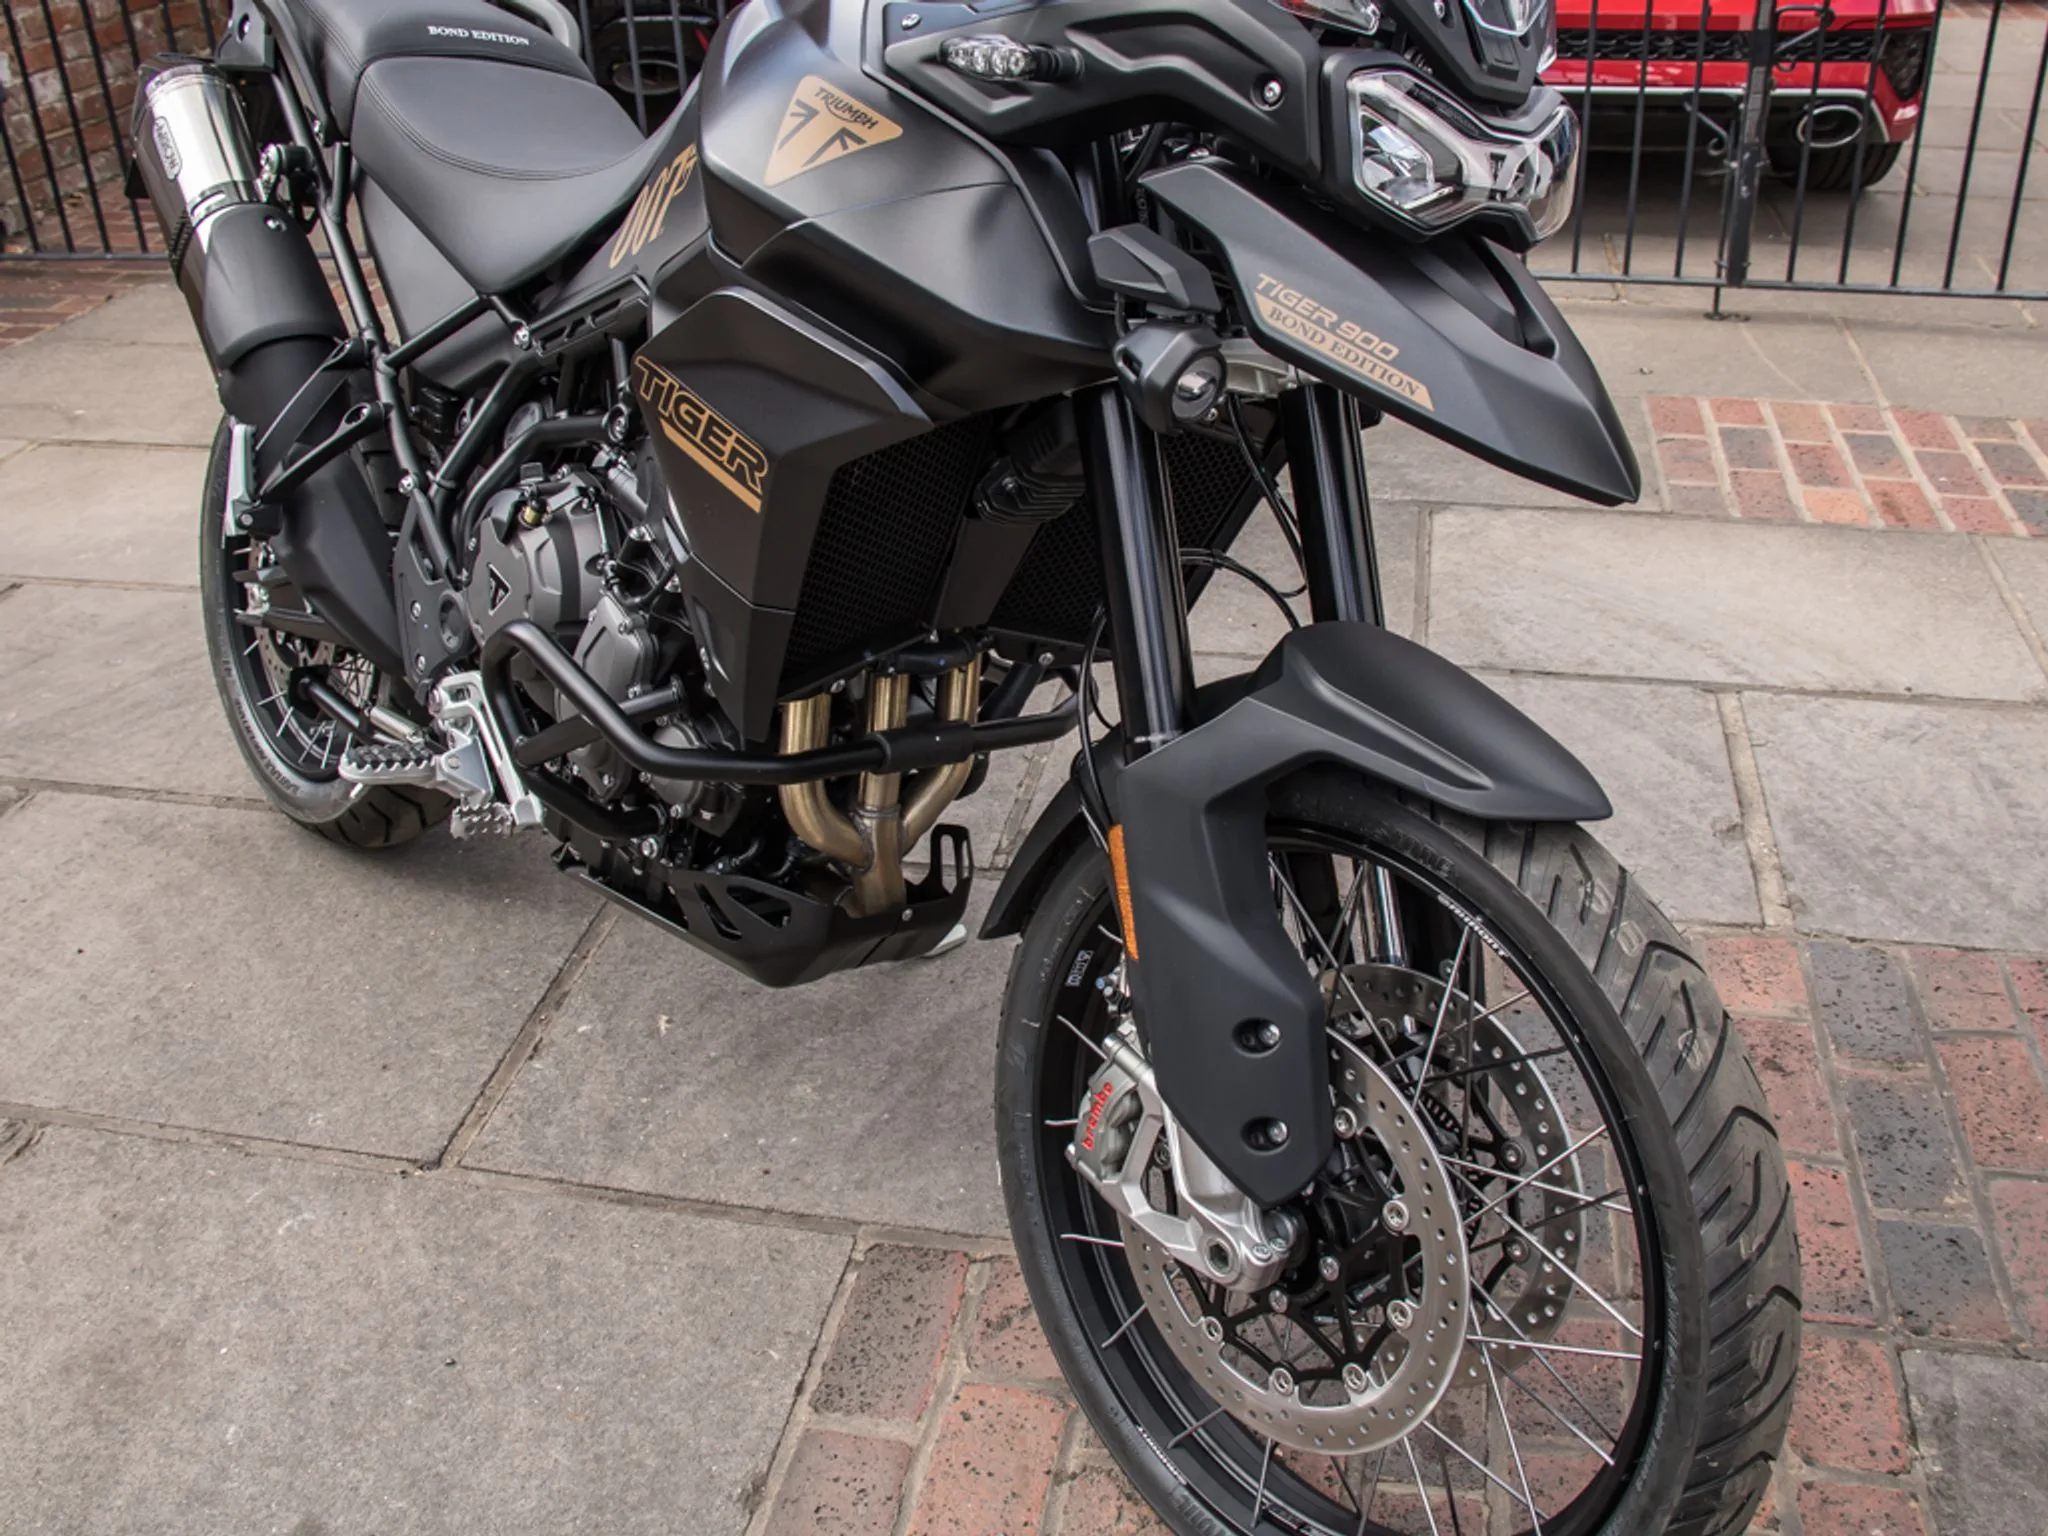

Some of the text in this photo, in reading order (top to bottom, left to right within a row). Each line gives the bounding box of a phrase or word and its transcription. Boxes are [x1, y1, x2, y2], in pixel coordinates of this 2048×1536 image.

[427, 25, 530, 46] BOND EDITION
[814, 86, 880, 130] TRIUMPH
[1256, 273, 1400, 362] TIGER 900
[1269, 306, 1420, 397] BOND EDITION
[634, 355, 768, 496] TIGER
[1081, 1082, 1114, 1151] brembo
